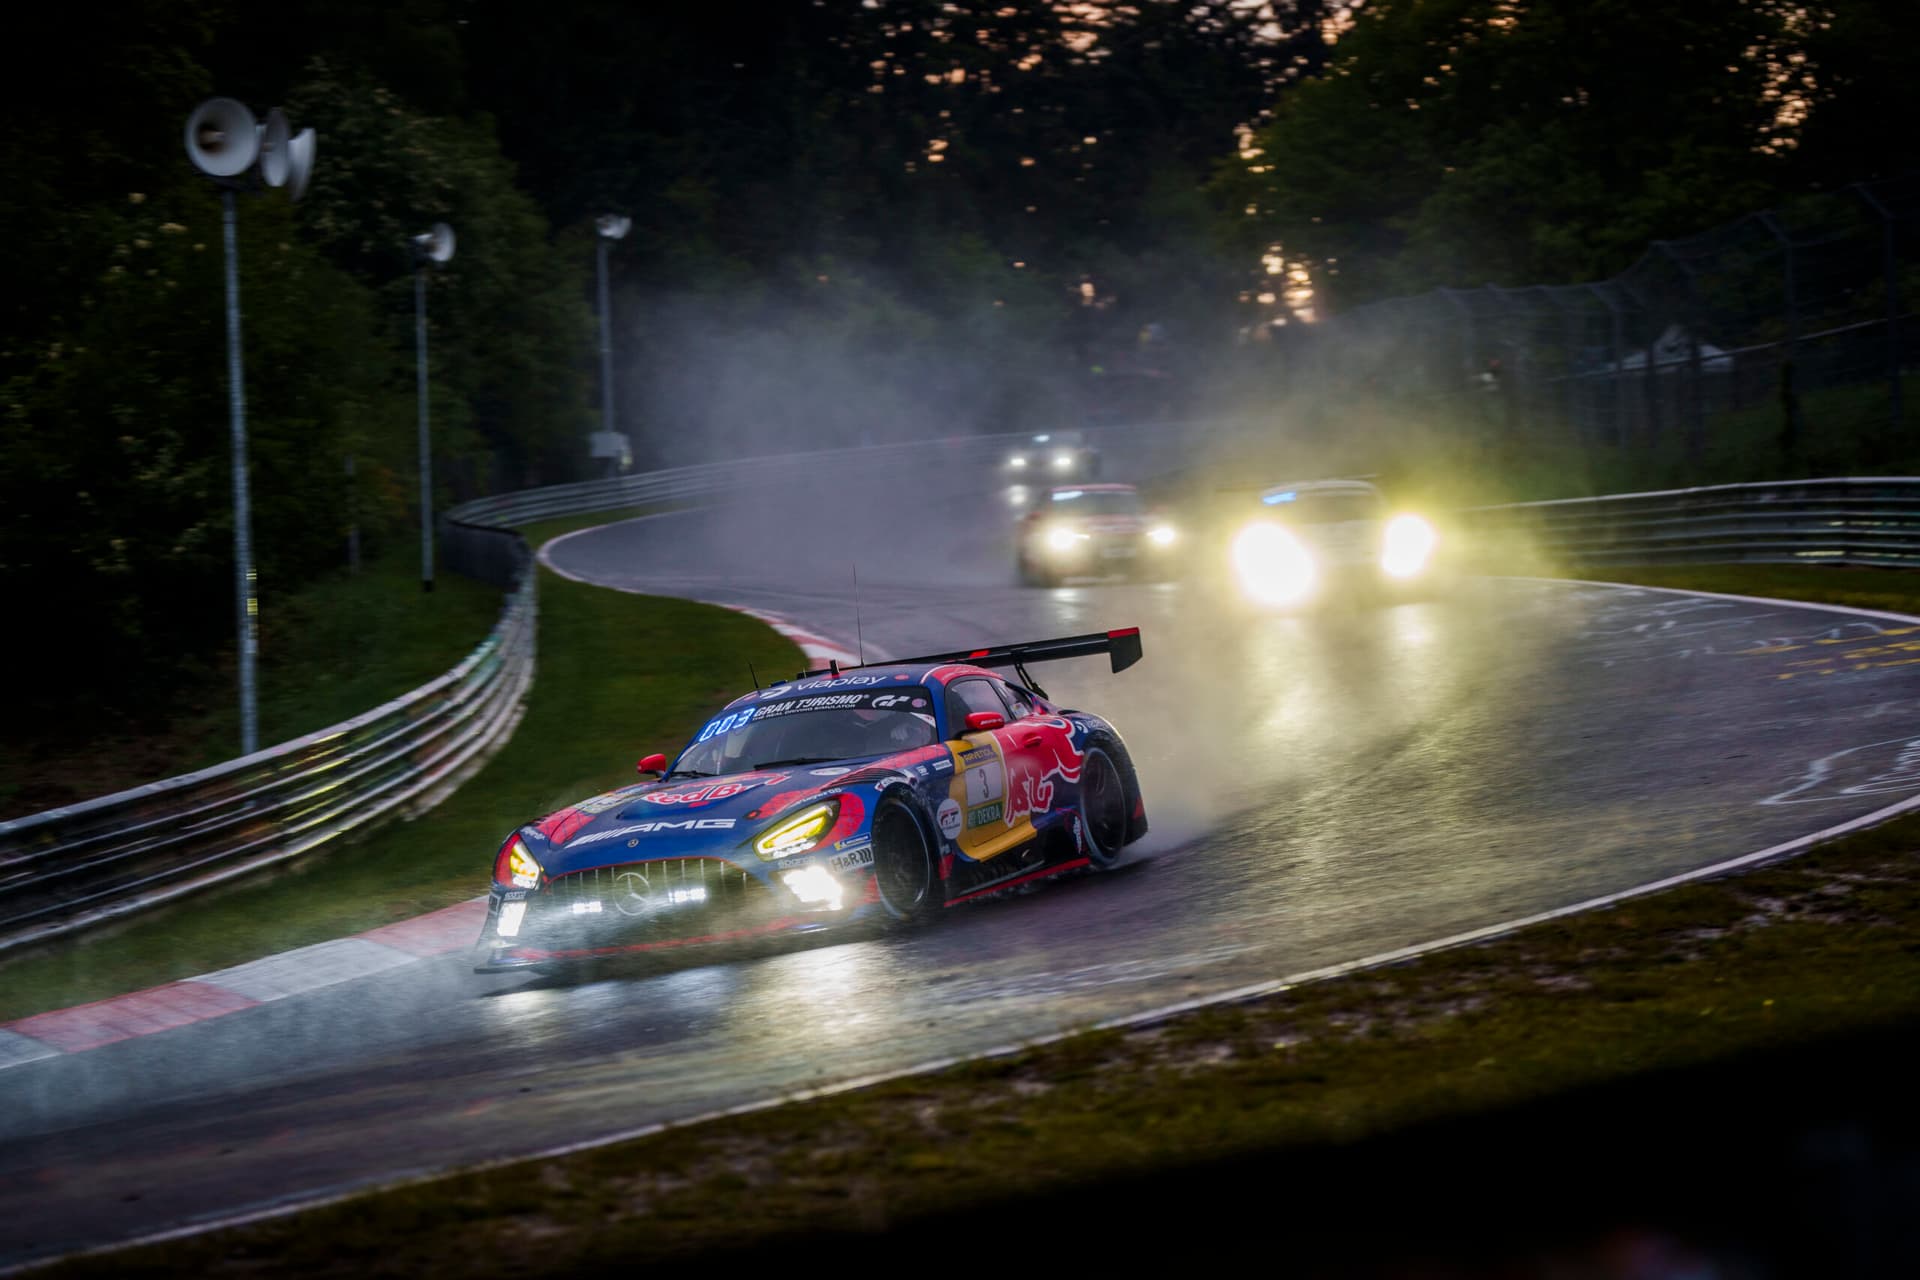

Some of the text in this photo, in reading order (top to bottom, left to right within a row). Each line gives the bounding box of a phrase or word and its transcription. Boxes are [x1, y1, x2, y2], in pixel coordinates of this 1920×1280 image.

[797, 675, 887, 691] viaplay
[754, 700, 796, 718] GRAN
[699, 707, 756, 742] 003
[979, 768, 990, 799] 3
[978, 805, 1001, 825] DEKRA
[619, 818, 737, 835] AMG
